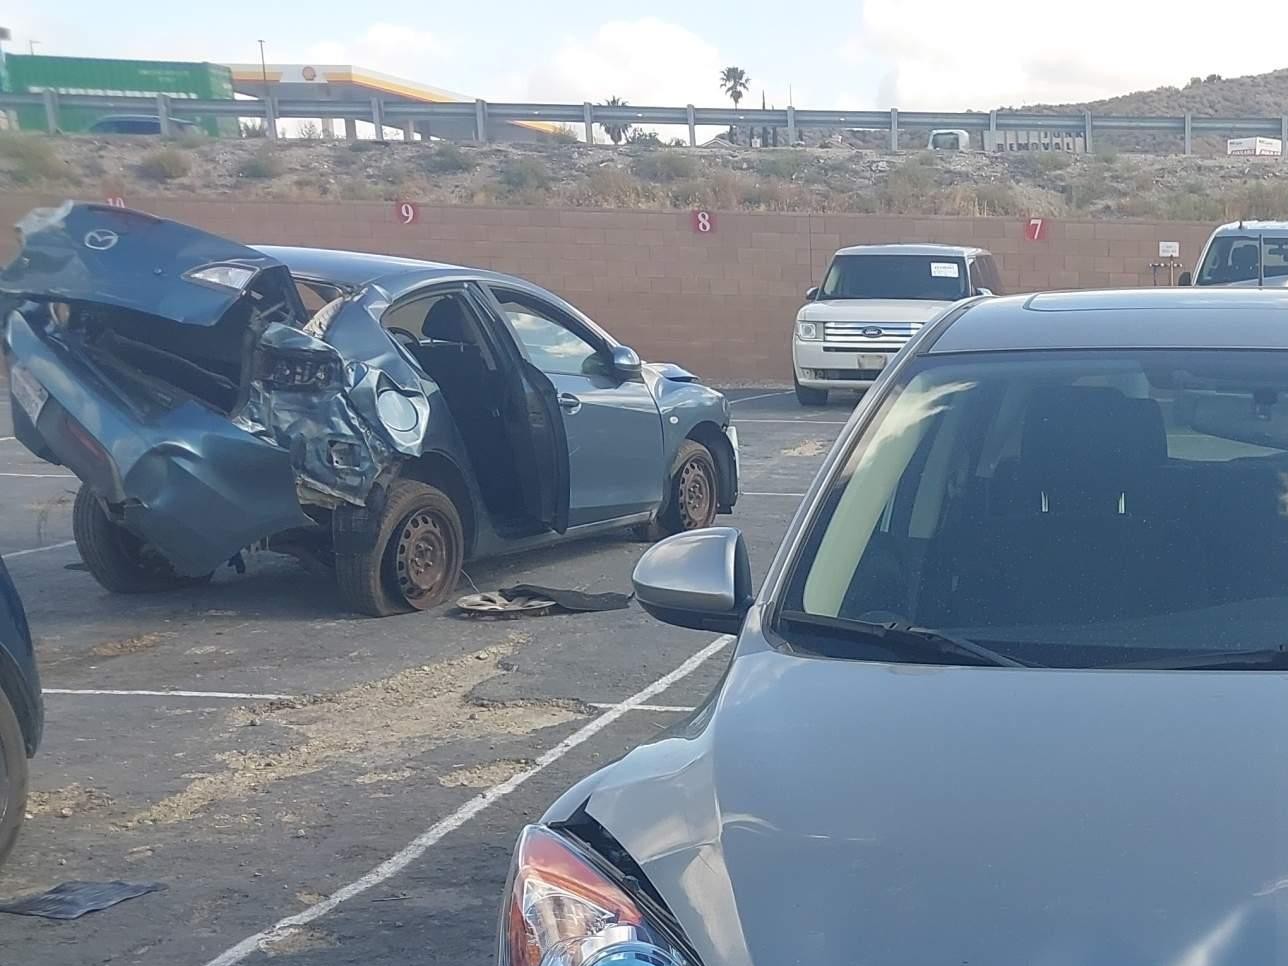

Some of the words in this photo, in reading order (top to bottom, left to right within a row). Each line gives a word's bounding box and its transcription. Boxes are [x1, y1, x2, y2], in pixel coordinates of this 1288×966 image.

[996, 142, 1072, 153] REMOVAL
[401, 203, 414, 224] 9
[698, 211, 710, 232] 8
[1030, 219, 1042, 240] 7
